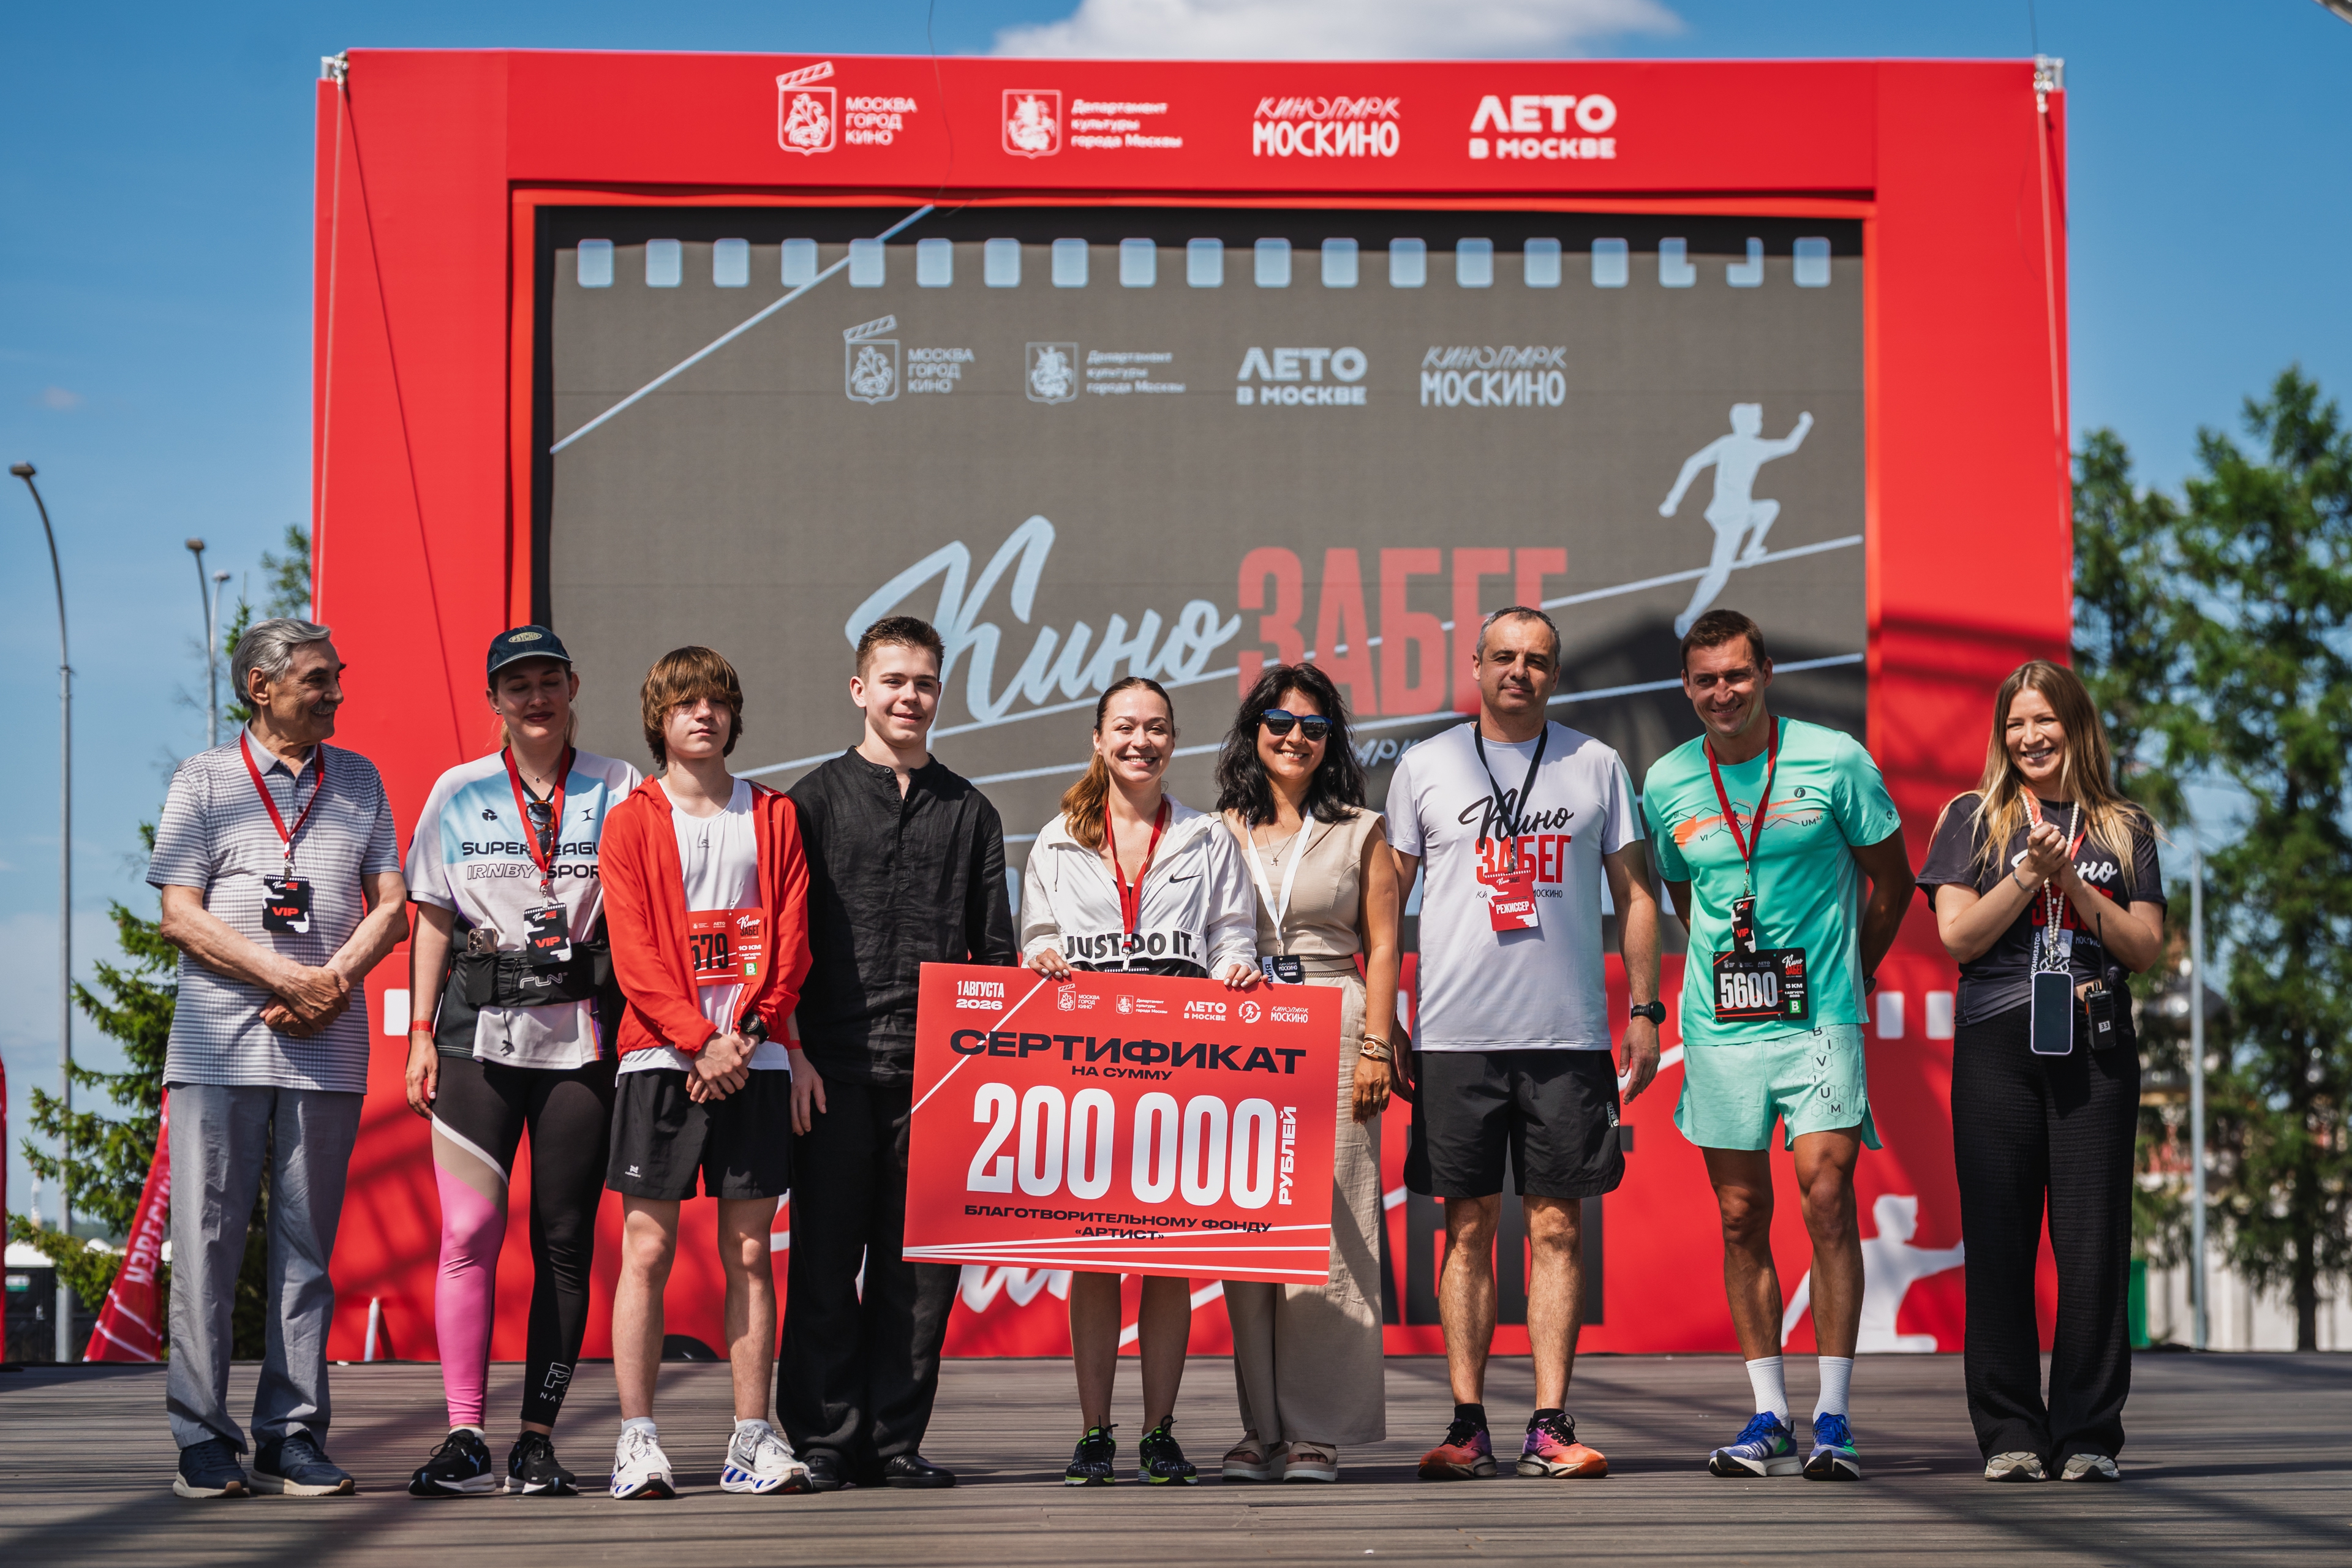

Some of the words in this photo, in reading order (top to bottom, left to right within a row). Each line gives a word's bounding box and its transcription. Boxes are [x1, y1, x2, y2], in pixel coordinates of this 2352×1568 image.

[845, 97, 918, 113] МОСКВА
[1071, 99, 1168, 115] Департамент
[1254, 96, 1401, 119] КИНОПАРК
[845, 114, 903, 130] ГОРОД
[1469, 94, 1618, 134] ЛЕТО
[1071, 118, 1140, 132] культуры
[845, 130, 893, 145] КИНО
[1071, 135, 1121, 149] города
[1125, 135, 1183, 148] Москвы
[1253, 121, 1400, 157] МОСКИНО
[1469, 138, 1489, 159] В
[1496, 137, 1617, 159] МОСКВЕ
[908, 348, 974, 363] МОСКВА
[1421, 346, 1568, 369] КИНОПАРК
[908, 363, 962, 380] ГОРОД
[1237, 346, 1368, 382] ЛЕТО
[908, 379, 953, 393] КИНО
[1420, 370, 1567, 407] МОСКИНО
[1236, 385, 1255, 405] В
[1260, 385, 1367, 405] МОСКВЕ
[510, 632, 540, 642] PSYCHO
[845, 514, 1242, 750] Кино
[1458, 788, 1574, 850] Кино
[552, 842, 598, 856] EAG
[467, 864, 538, 880] IRNBY
[272, 907, 299, 917] VIP
[1496, 901, 1530, 914] РЕЖИССЕР
[736, 914, 761, 930] Кино
[740, 925, 760, 936] ЗАБЕГ
[1736, 927, 1749, 938] VIP
[535, 936, 560, 948] VIP
[1065, 933, 1121, 959] JUST
[1127, 933, 1168, 956] DO
[1173, 930, 1197, 960] IT.
[1782, 954, 1803, 968] Кино
[2030, 932, 2041, 980] ОРГАНИЗАТОР
[1785, 964, 1803, 975] ЗАБЕГ
[957, 981, 962, 996] 1
[963, 981, 1005, 998] АВГУСТА
[1720, 971, 1778, 1009] 5600
[956, 998, 1003, 1011] 2026
[1184, 1000, 1227, 1014] ЛЕТО
[1271, 1005, 1309, 1014] КИНОПАРК
[1191, 1013, 1226, 1022] МОСКВЕ
[1270, 1012, 1308, 1023] МОСКИНО
[950, 1029, 1306, 1074] СЕРТИФИКАТ
[1072, 1066, 1099, 1077] НА
[1102, 1067, 1173, 1081] СУММУ
[967, 1082, 1115, 1200] 200
[1131, 1092, 1277, 1210] 000
[1278, 1106, 1297, 1205] РУБЛЕЙ
[964, 1205, 1199, 1228] БЛАГОТВОРИТЕЛЬНОМУ
[1200, 1219, 1272, 1233] ФОНДУ
[1075, 1227, 1165, 1241] «АРТИСТ»
